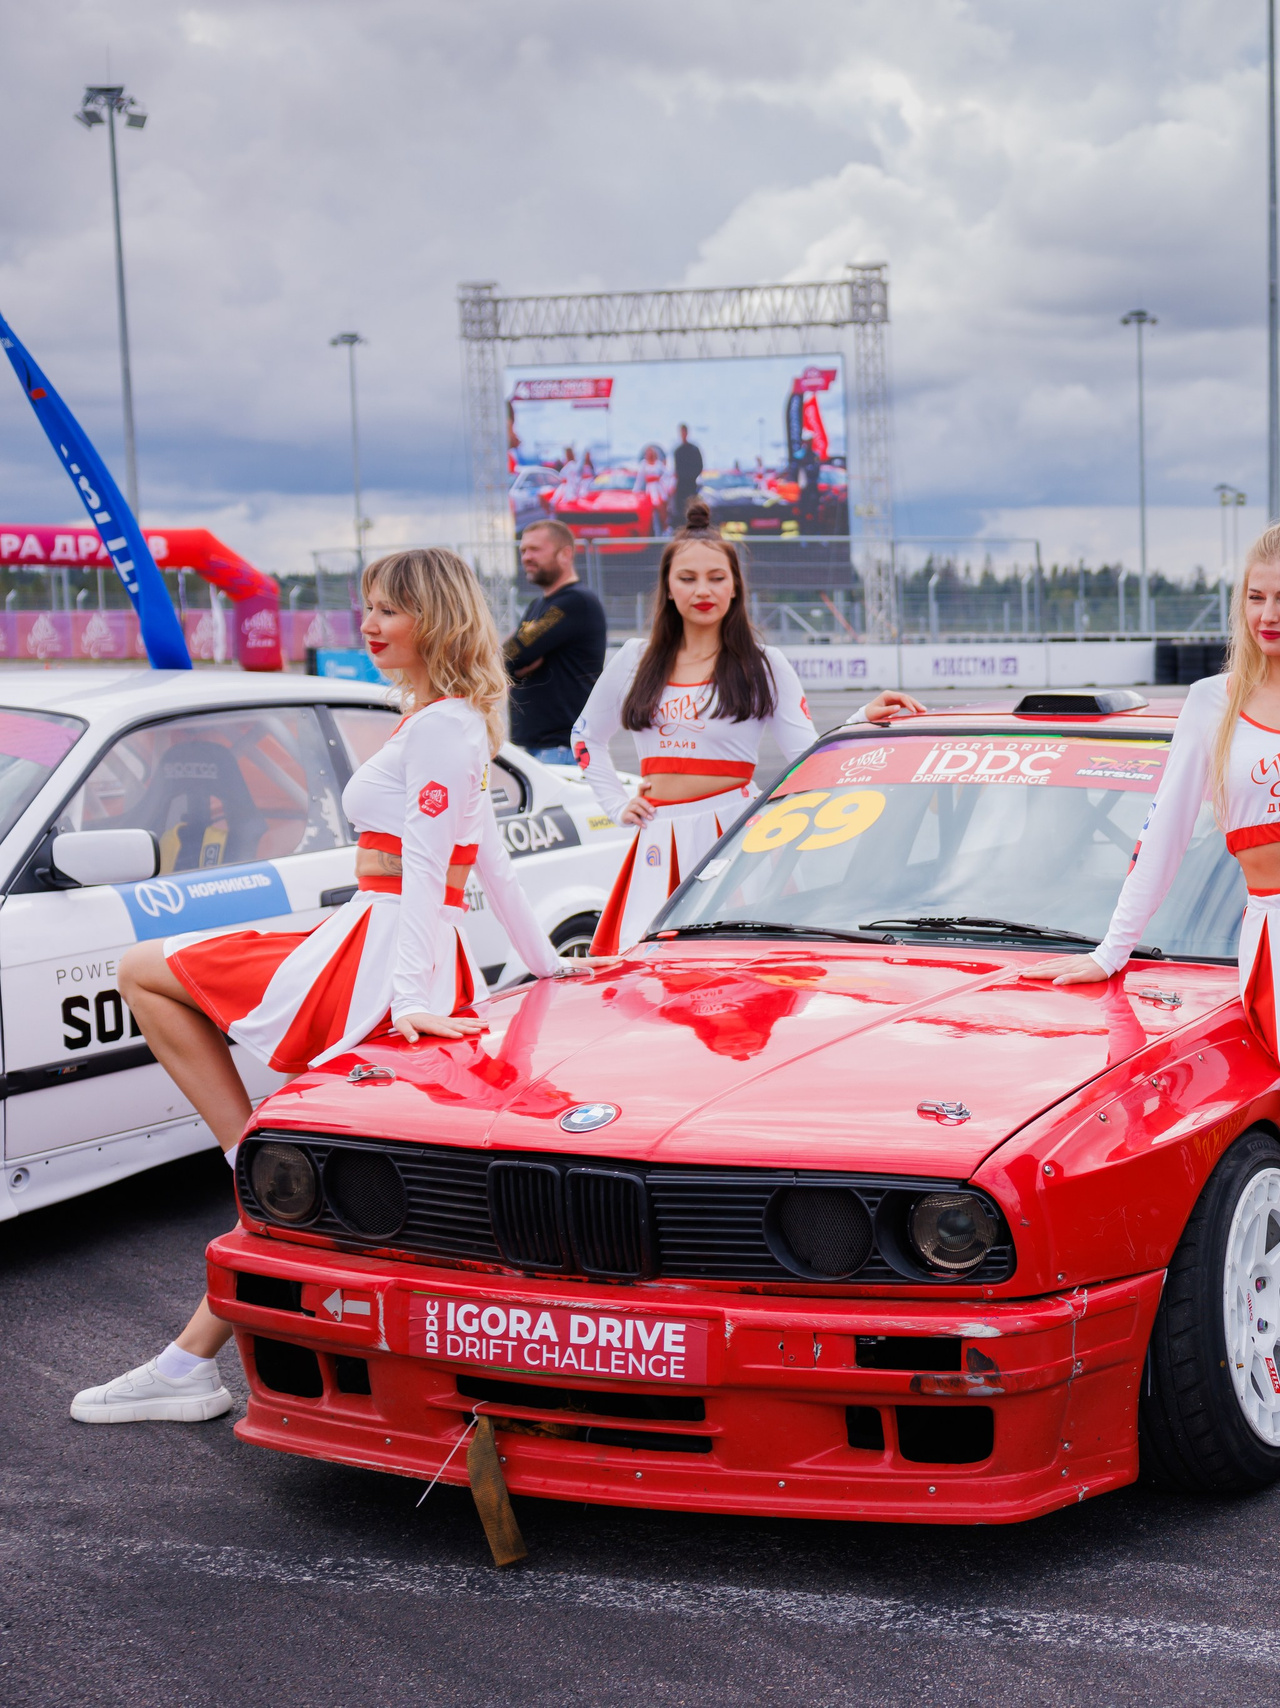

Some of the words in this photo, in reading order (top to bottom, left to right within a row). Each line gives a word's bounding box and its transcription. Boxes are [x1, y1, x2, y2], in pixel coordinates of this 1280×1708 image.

[659, 739, 697, 750] ДРАЙВ
[932, 742, 994, 752] IGORA
[1006, 743, 1069, 753] DRIVE
[916, 750, 1062, 776] IDDC
[1075, 768, 1154, 781] MATSURI
[910, 774, 957, 783] DRIFT
[957, 774, 1051, 785] CHALLENGE
[742, 790, 886, 853] 69
[186, 873, 272, 899] НОРНИКЕЛЬ
[56, 959, 122, 985] POWE
[425, 1300, 440, 1354] IDDC
[446, 1302, 559, 1343] IGORA
[569, 1314, 686, 1354] DRIVE
[446, 1334, 517, 1363] DRIFT
[523, 1342, 686, 1379] CHALLENGE
